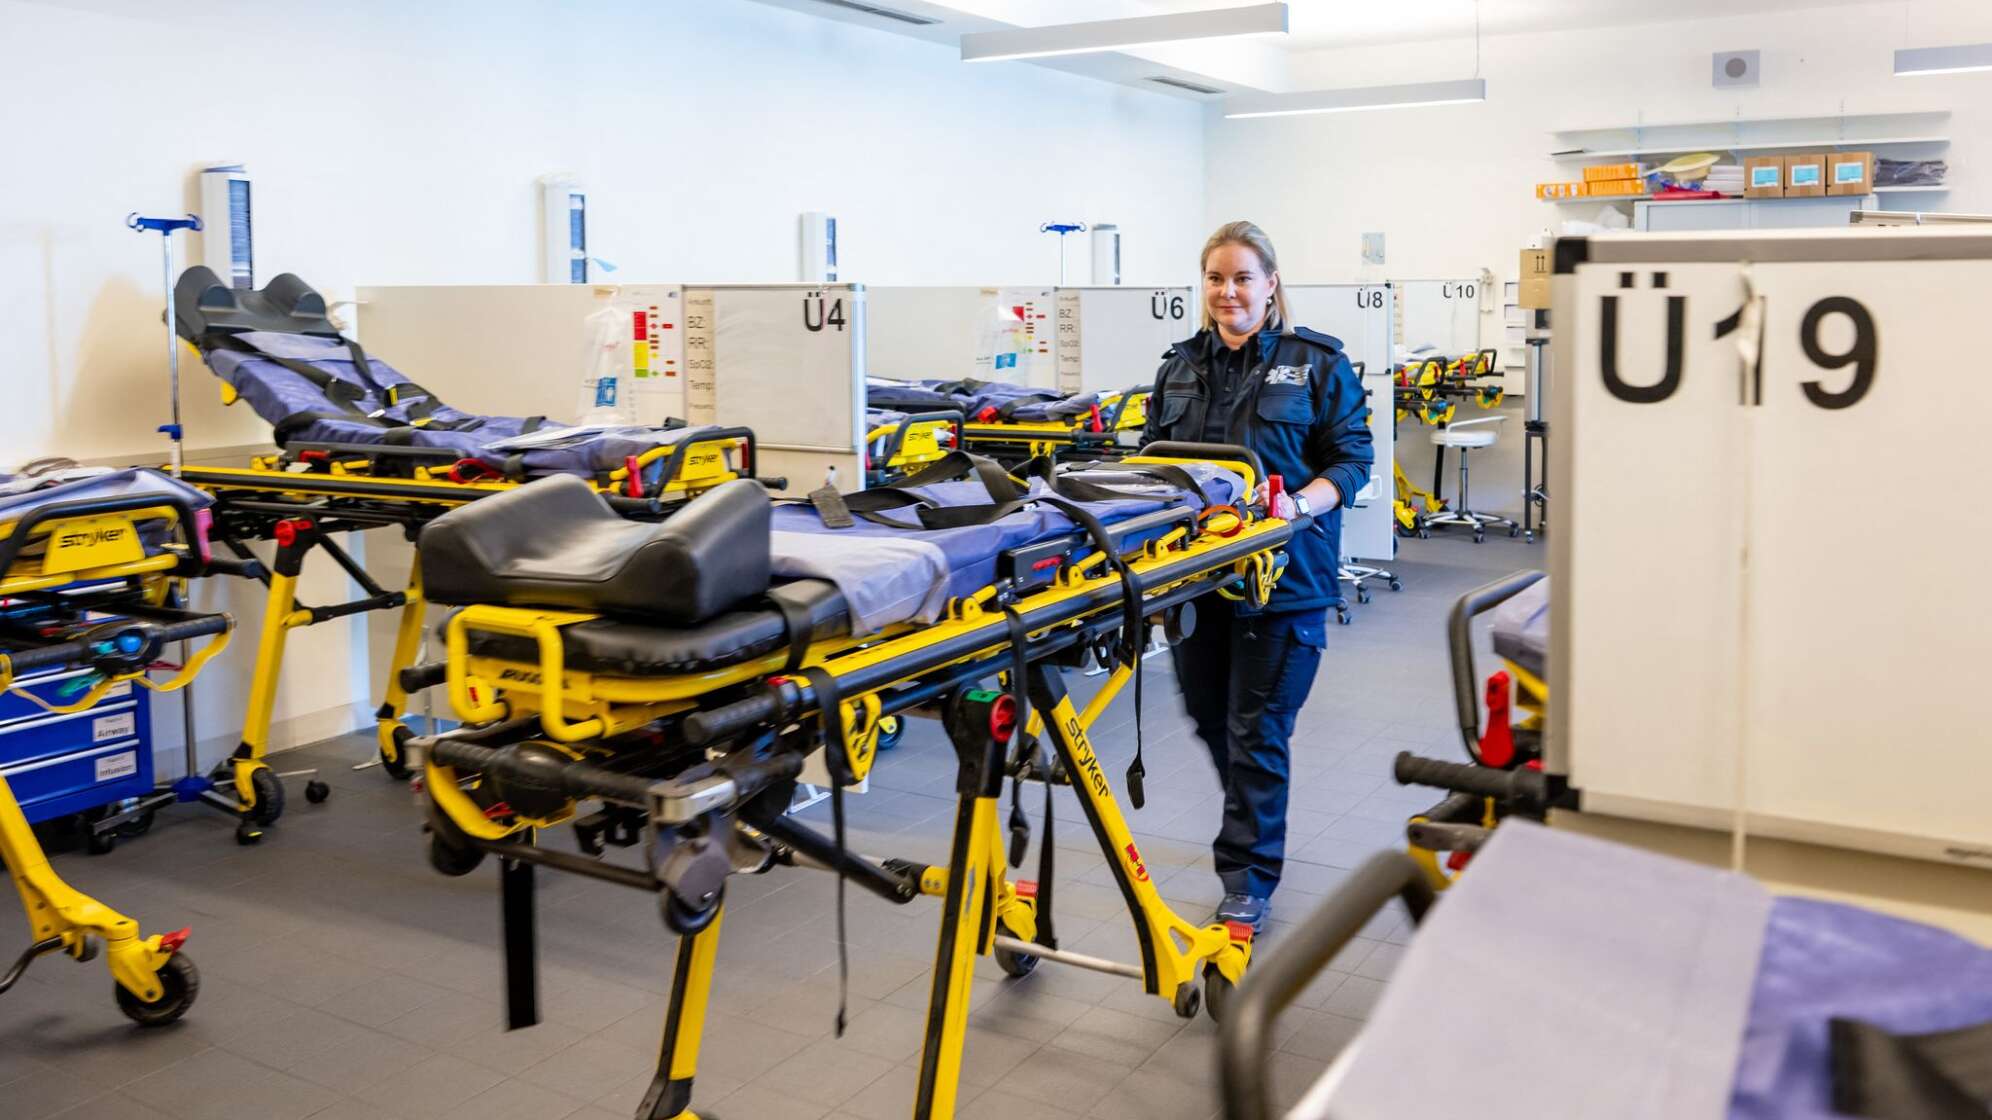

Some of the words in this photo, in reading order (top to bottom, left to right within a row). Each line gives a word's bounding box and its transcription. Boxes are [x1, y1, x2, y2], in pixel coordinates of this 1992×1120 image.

[804, 291, 846, 332] Ü4
[1152, 291, 1184, 320] Ü6
[1357, 287, 1383, 309] Ü8
[60, 528, 125, 548] stryker
[1065, 717, 1109, 797] stryker
